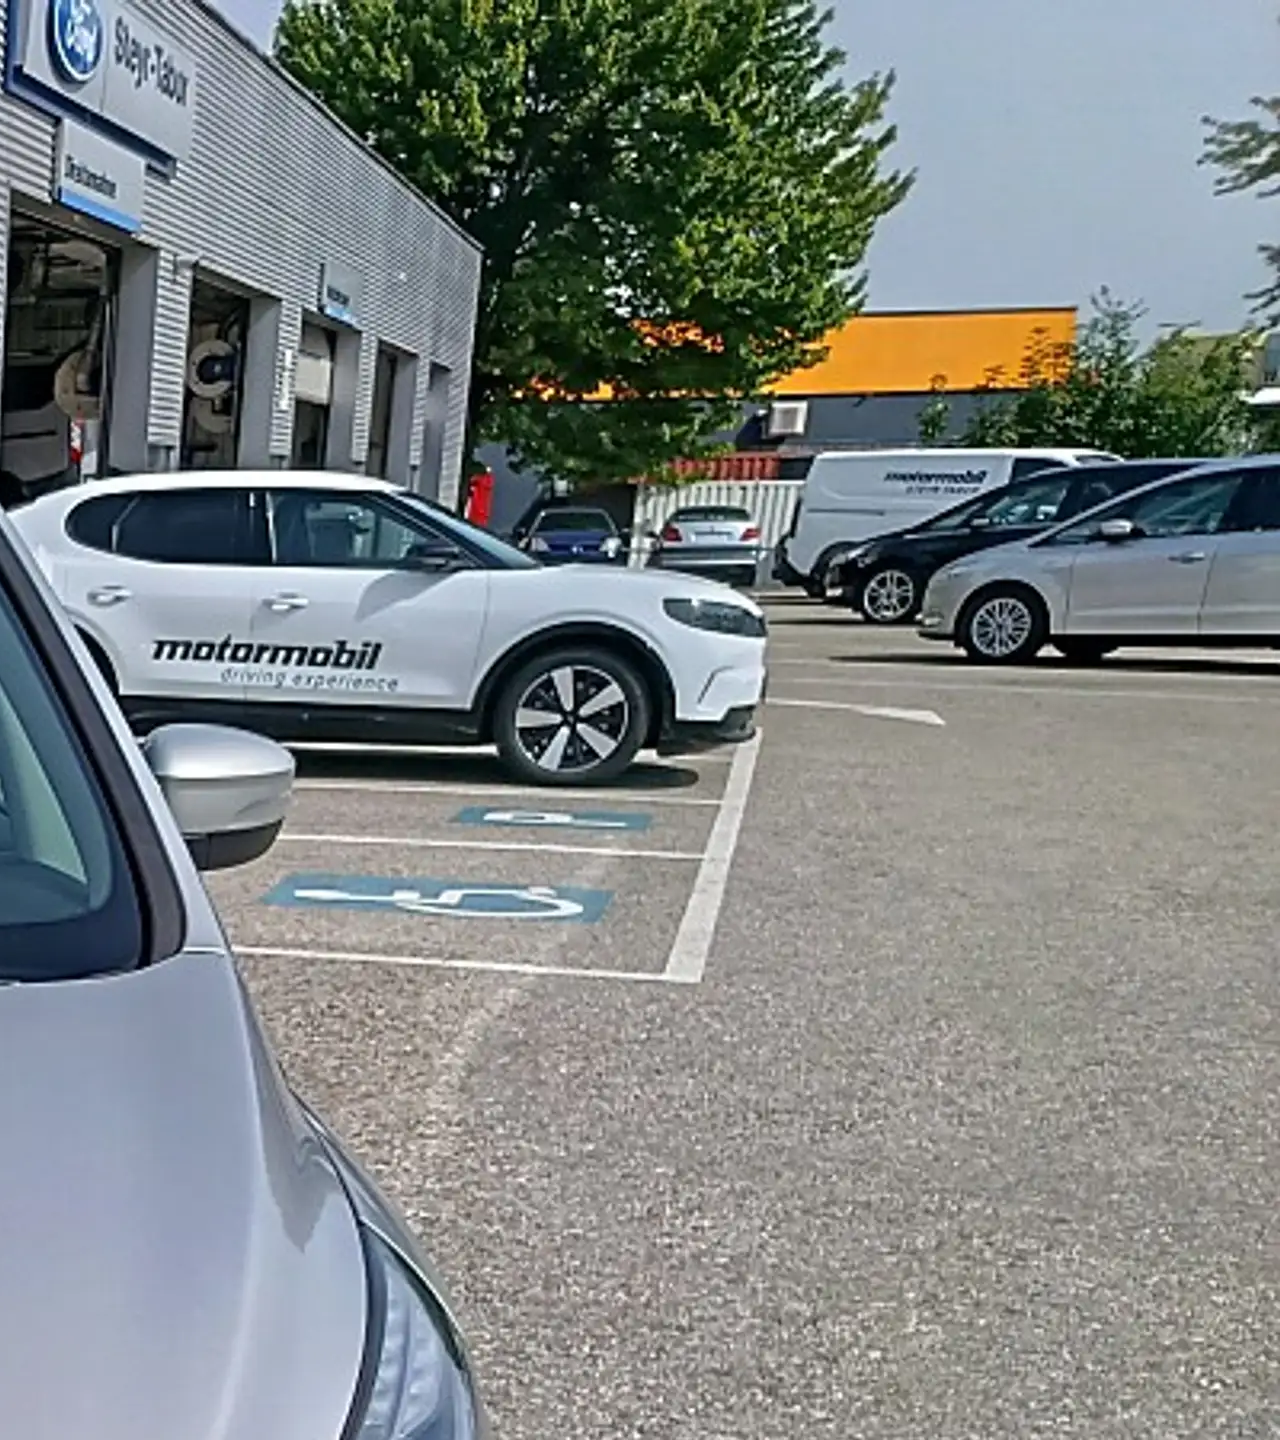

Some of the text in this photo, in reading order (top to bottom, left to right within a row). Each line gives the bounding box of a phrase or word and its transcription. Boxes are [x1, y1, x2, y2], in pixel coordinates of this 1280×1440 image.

[883, 469, 988, 484] motormobil
[152, 634, 383, 670] motormobil
[220, 667, 400, 693] driving experience
